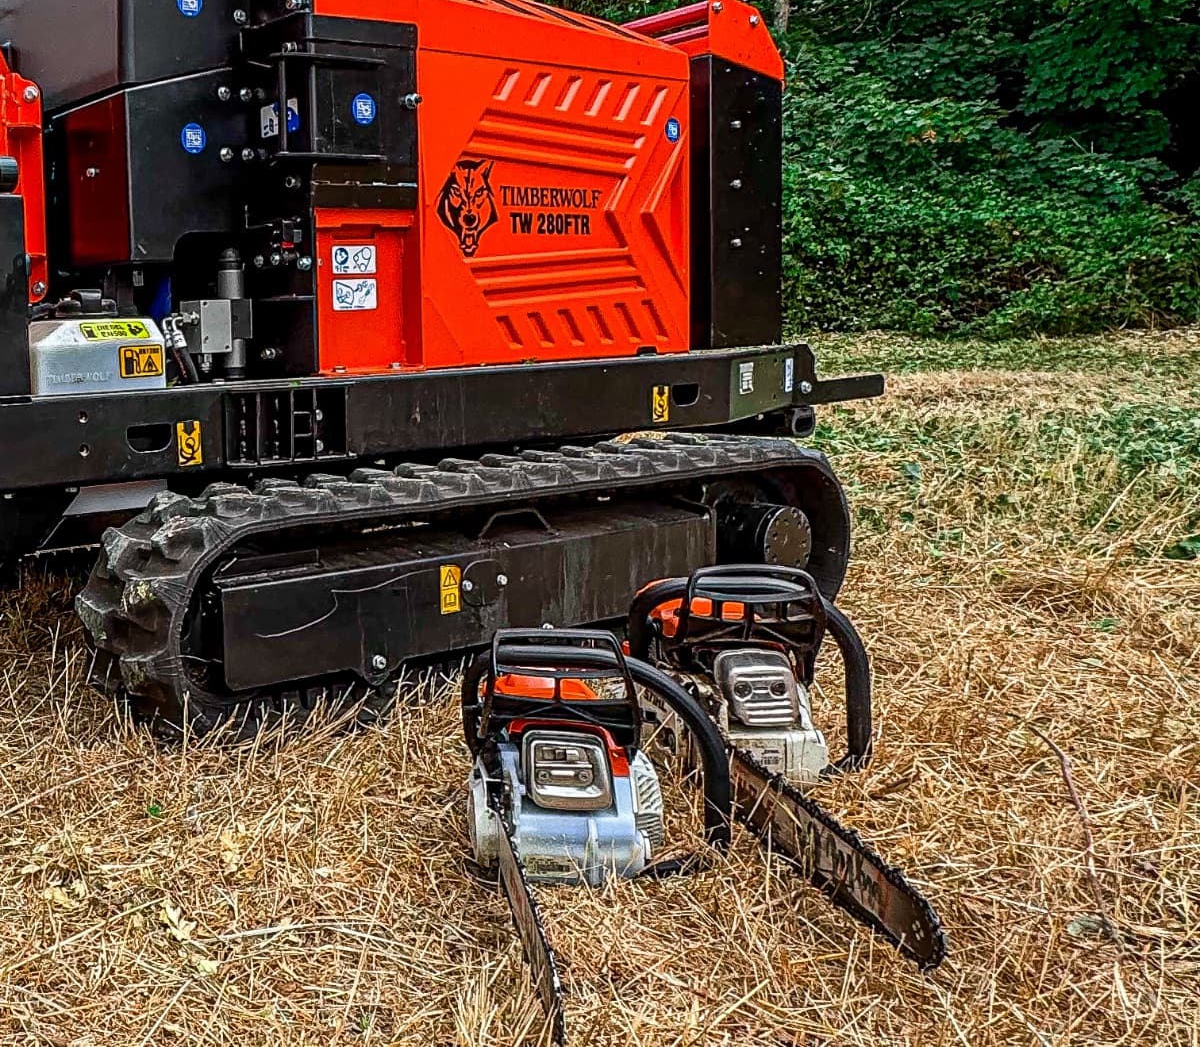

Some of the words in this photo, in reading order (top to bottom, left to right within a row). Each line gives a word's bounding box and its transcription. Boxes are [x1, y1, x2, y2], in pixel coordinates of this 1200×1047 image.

[500, 185, 602, 209] TIMBERWOLF
[509, 212, 533, 234] TW
[536, 213, 591, 235] 280FTR
